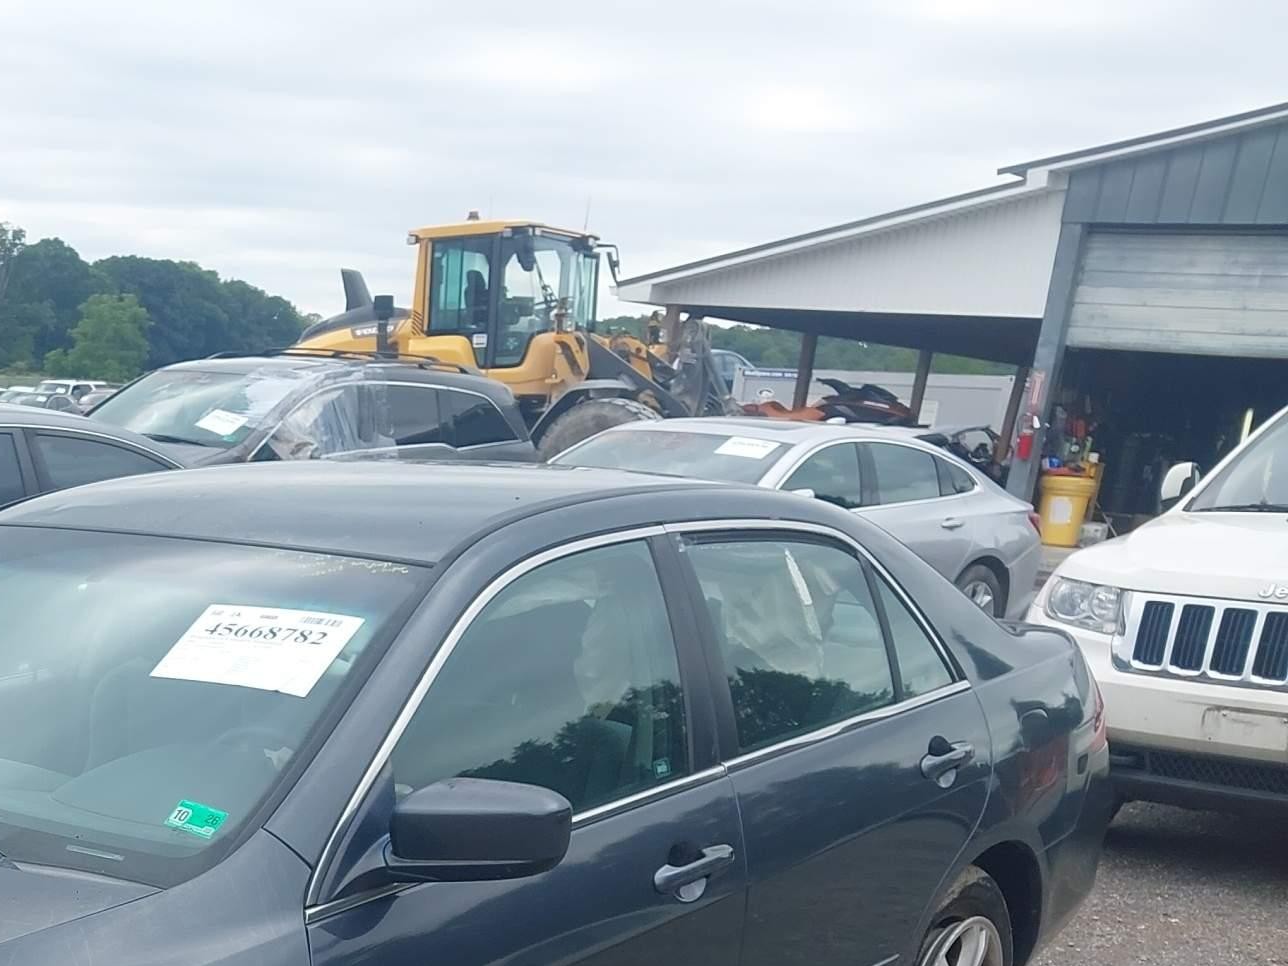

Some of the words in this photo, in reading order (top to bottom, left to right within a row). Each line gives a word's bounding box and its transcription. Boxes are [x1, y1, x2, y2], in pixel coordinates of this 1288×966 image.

[204, 622, 328, 645] 45668782
[173, 808, 190, 822] 10
[205, 814, 221, 826] 26
